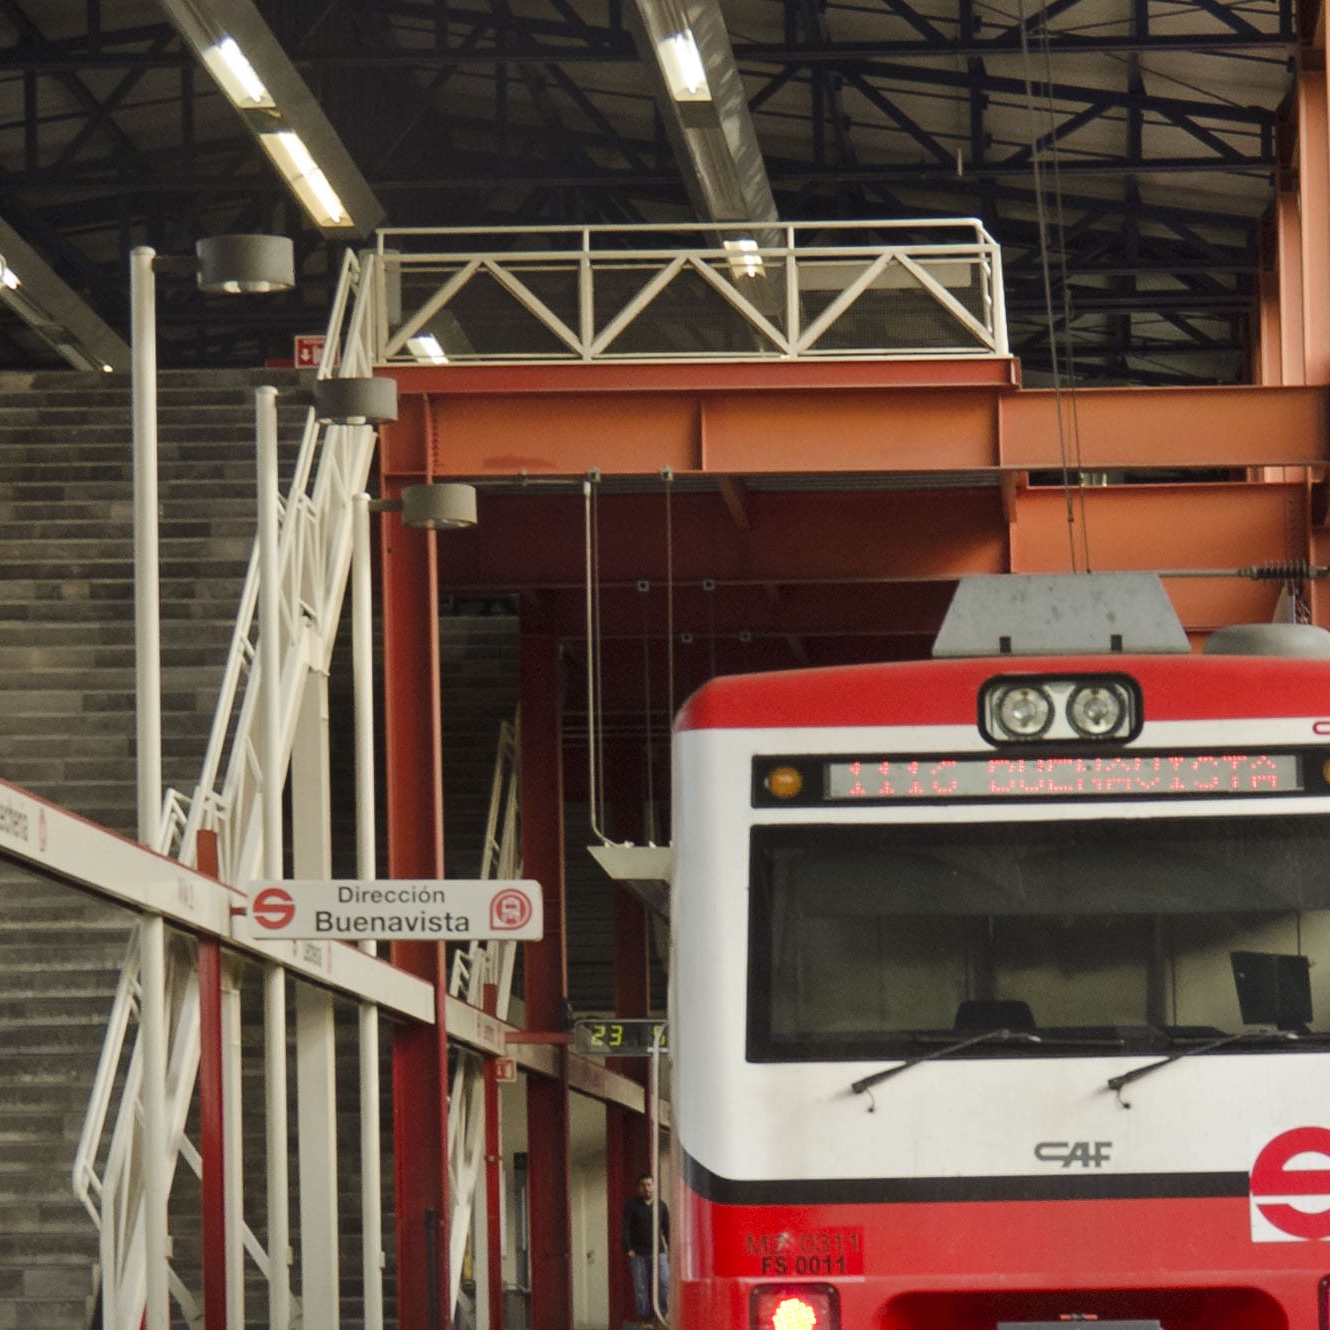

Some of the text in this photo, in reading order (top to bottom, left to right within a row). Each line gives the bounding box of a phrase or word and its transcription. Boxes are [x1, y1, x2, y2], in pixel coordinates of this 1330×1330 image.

[337, 886, 446, 904] Dirección
[315, 910, 470, 932] Buenavista
[1034, 1141, 1113, 1168] CAF
[761, 1255, 846, 1275] FS 0011
